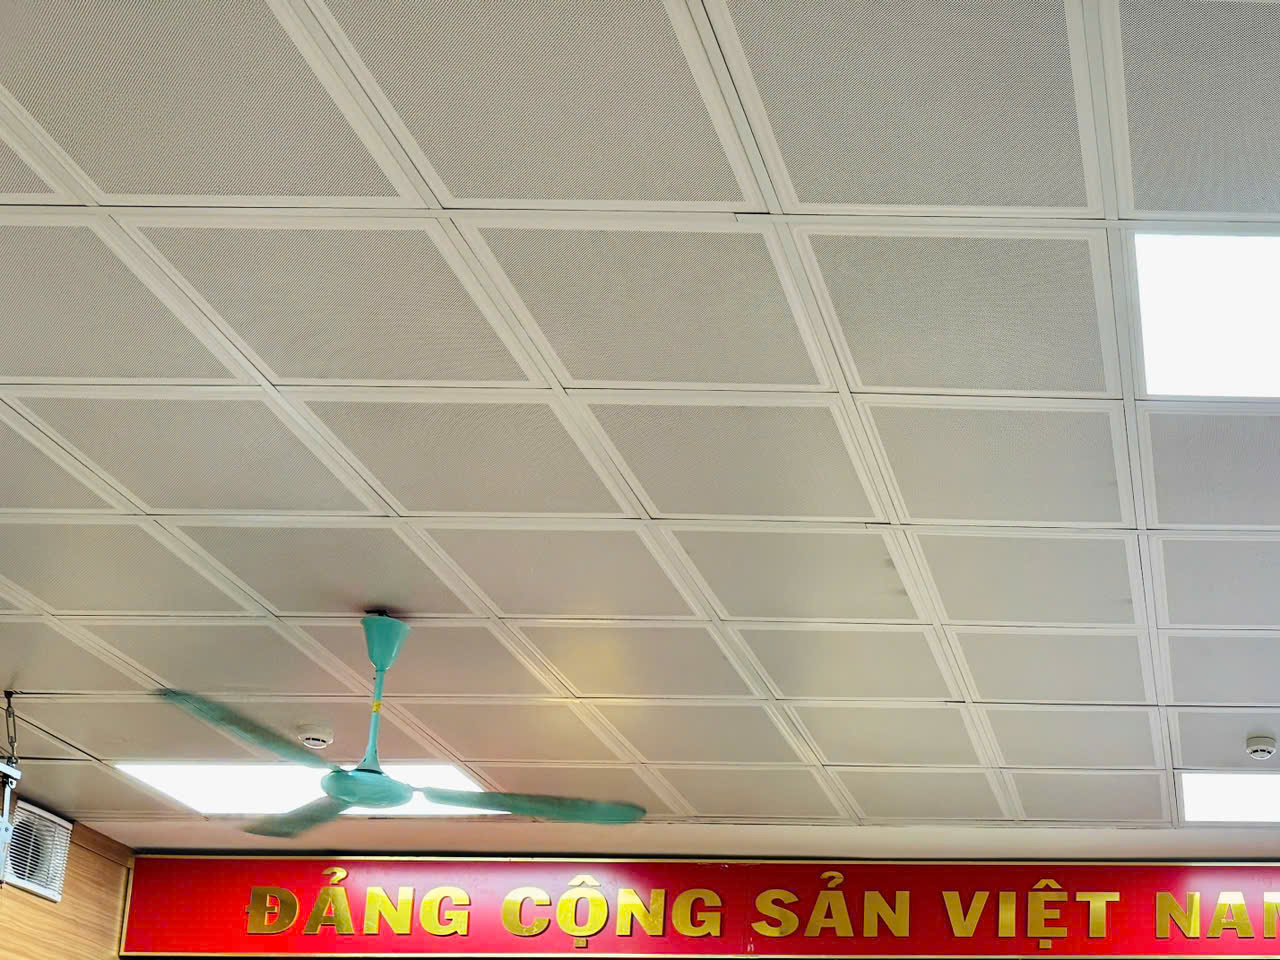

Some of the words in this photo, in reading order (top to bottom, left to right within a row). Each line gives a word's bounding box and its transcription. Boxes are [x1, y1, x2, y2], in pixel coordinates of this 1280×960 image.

[245, 866, 471, 937] ĐẢNG
[502, 874, 723, 949] CỘNG
[750, 870, 911, 938] SẢN
[941, 878, 1121, 949] VIỆT
